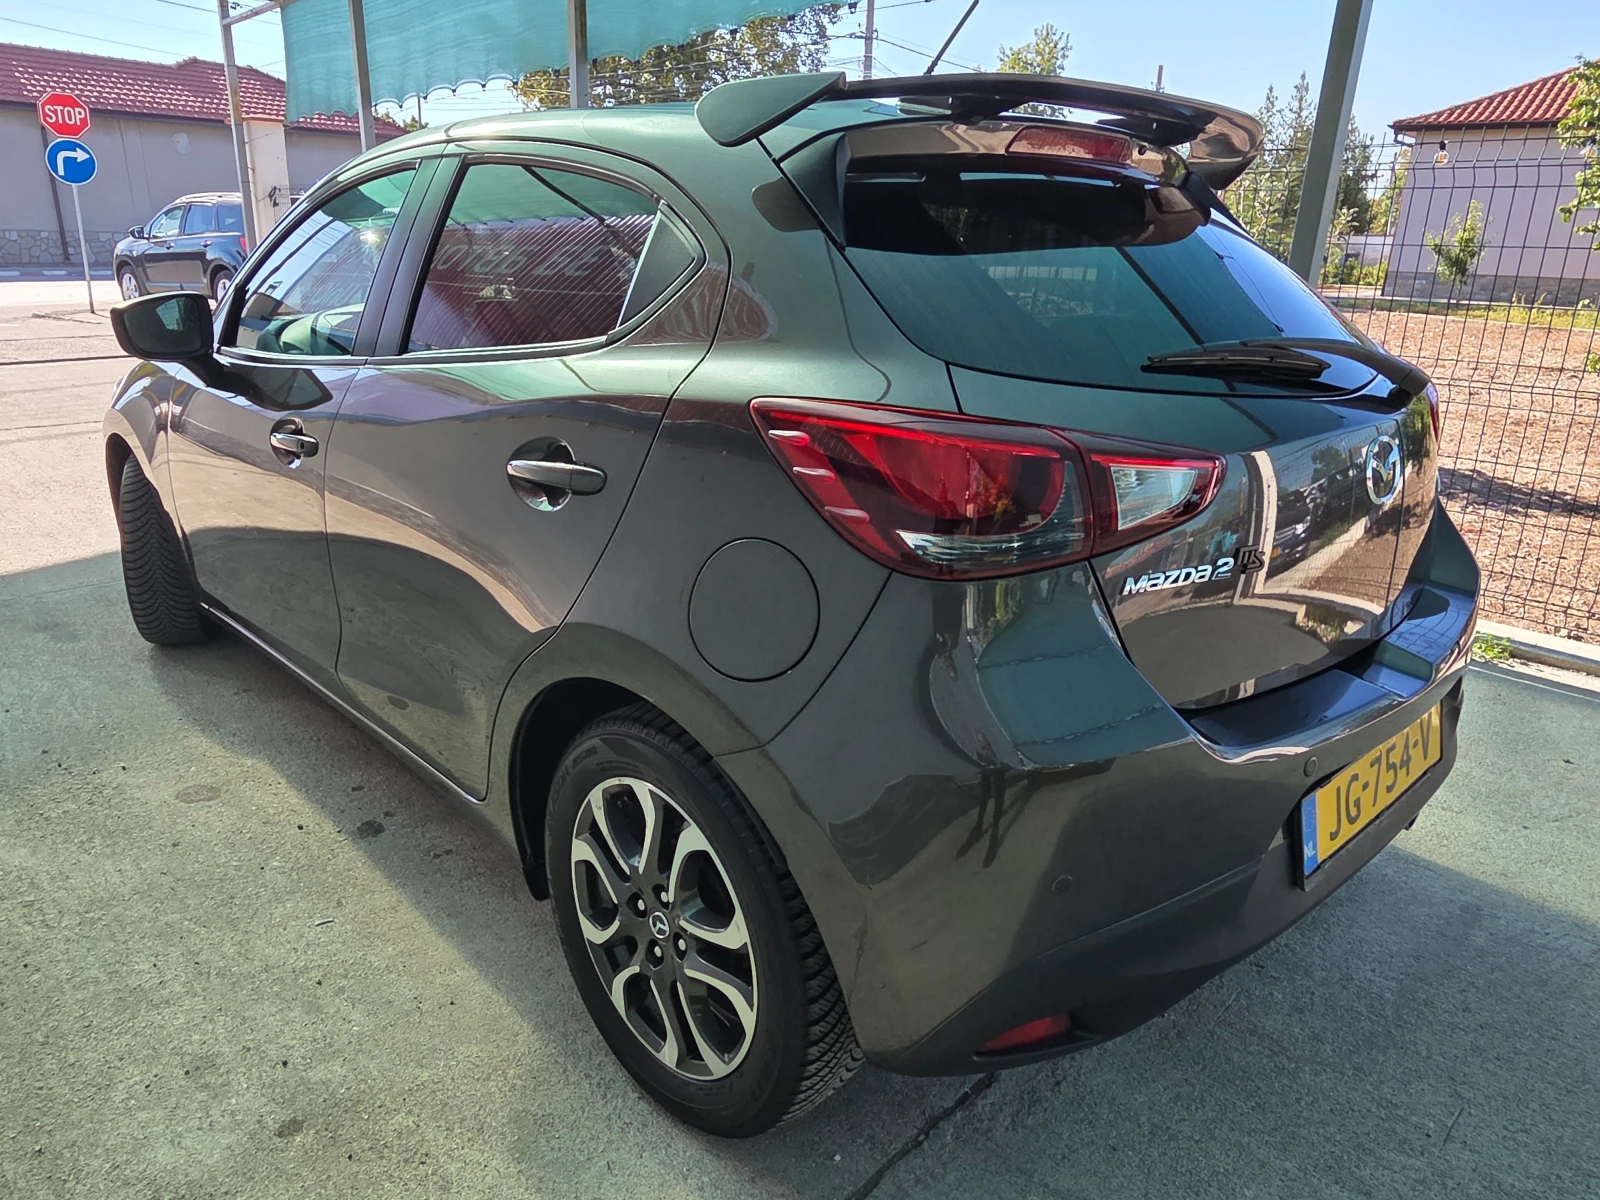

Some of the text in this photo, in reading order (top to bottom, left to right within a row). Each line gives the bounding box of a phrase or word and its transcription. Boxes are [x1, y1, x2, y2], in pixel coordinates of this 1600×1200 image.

[44, 104, 85, 125] STOP
[1329, 711, 1433, 842] JG-754-V
[1304, 841, 1316, 861] NL
